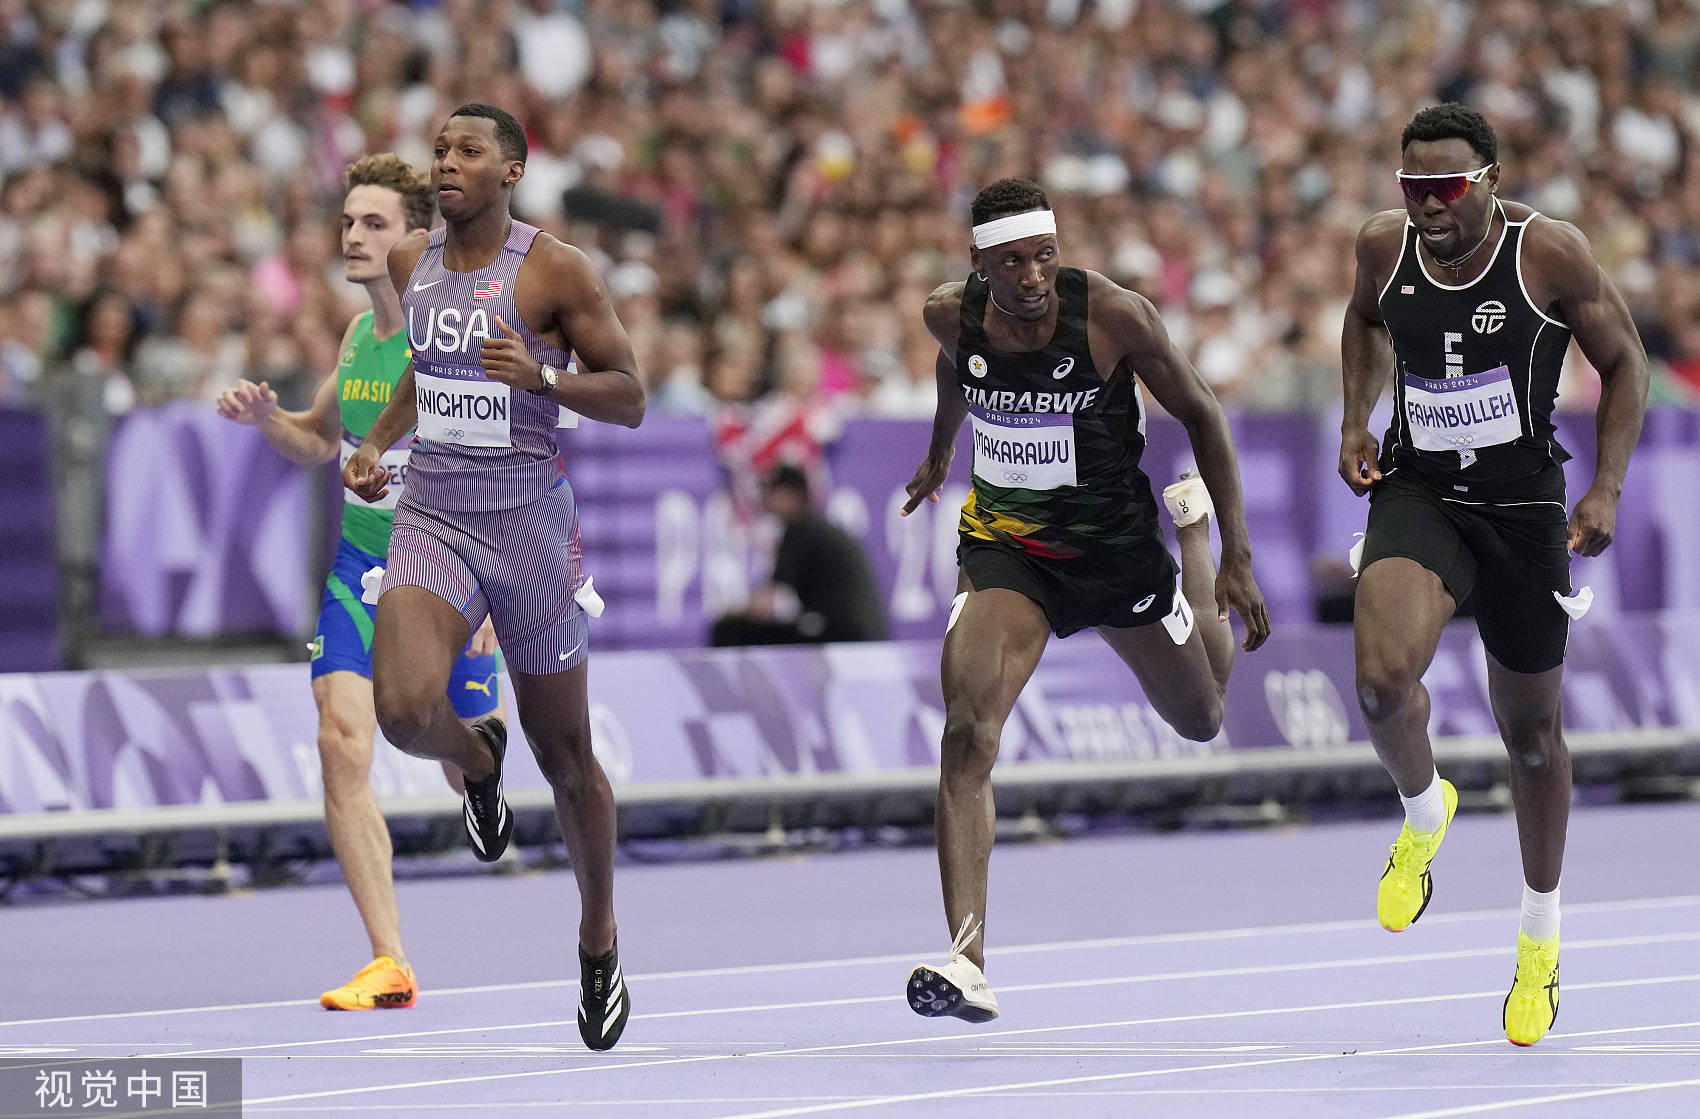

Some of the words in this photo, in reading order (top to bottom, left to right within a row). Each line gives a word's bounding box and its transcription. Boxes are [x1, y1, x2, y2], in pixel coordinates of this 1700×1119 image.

[408, 305, 490, 353] USA
[430, 365, 453, 376] PARIS
[454, 368, 480, 378] 2024
[1424, 380, 1448, 390] PARIS
[1451, 378, 1479, 388] 2024
[416, 384, 507, 421] KNIGHTON
[962, 383, 1100, 414] ZIMBABWE
[1407, 393, 1515, 429] FAHNBULLEH
[986, 412, 1011, 424] PARIS
[1013, 417, 1041, 425] 2024
[975, 428, 1069, 465] MAKARAWU
